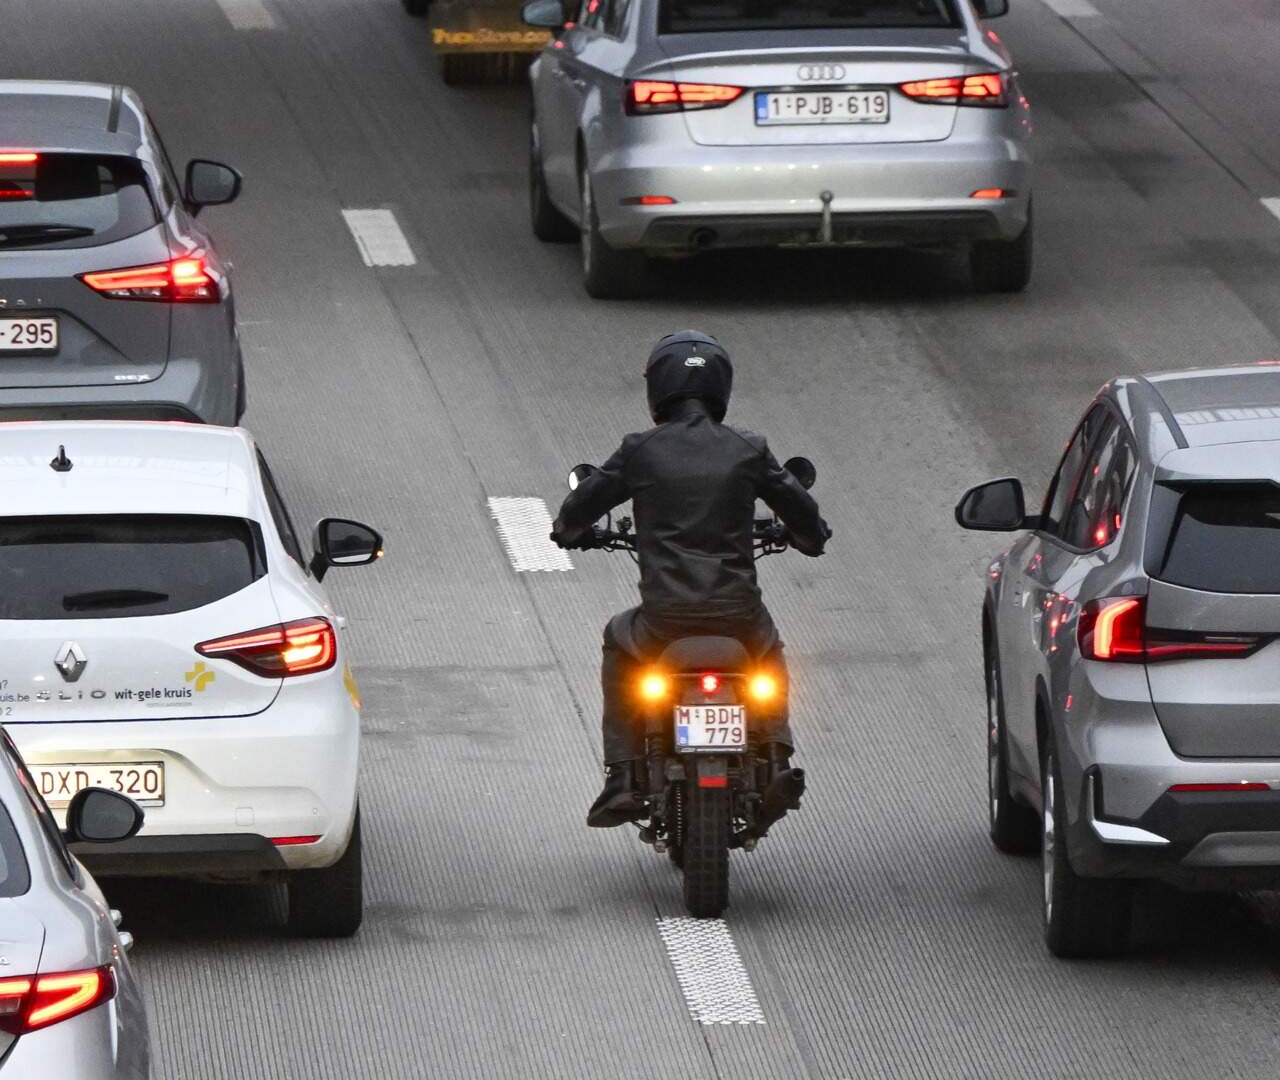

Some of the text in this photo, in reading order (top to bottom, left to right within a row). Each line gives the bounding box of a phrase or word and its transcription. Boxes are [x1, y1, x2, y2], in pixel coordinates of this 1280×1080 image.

[772, 95, 885, 115] 1-PJB-619
[114, 686, 192, 702] wit-gele kruis
[705, 727, 743, 744] 779
